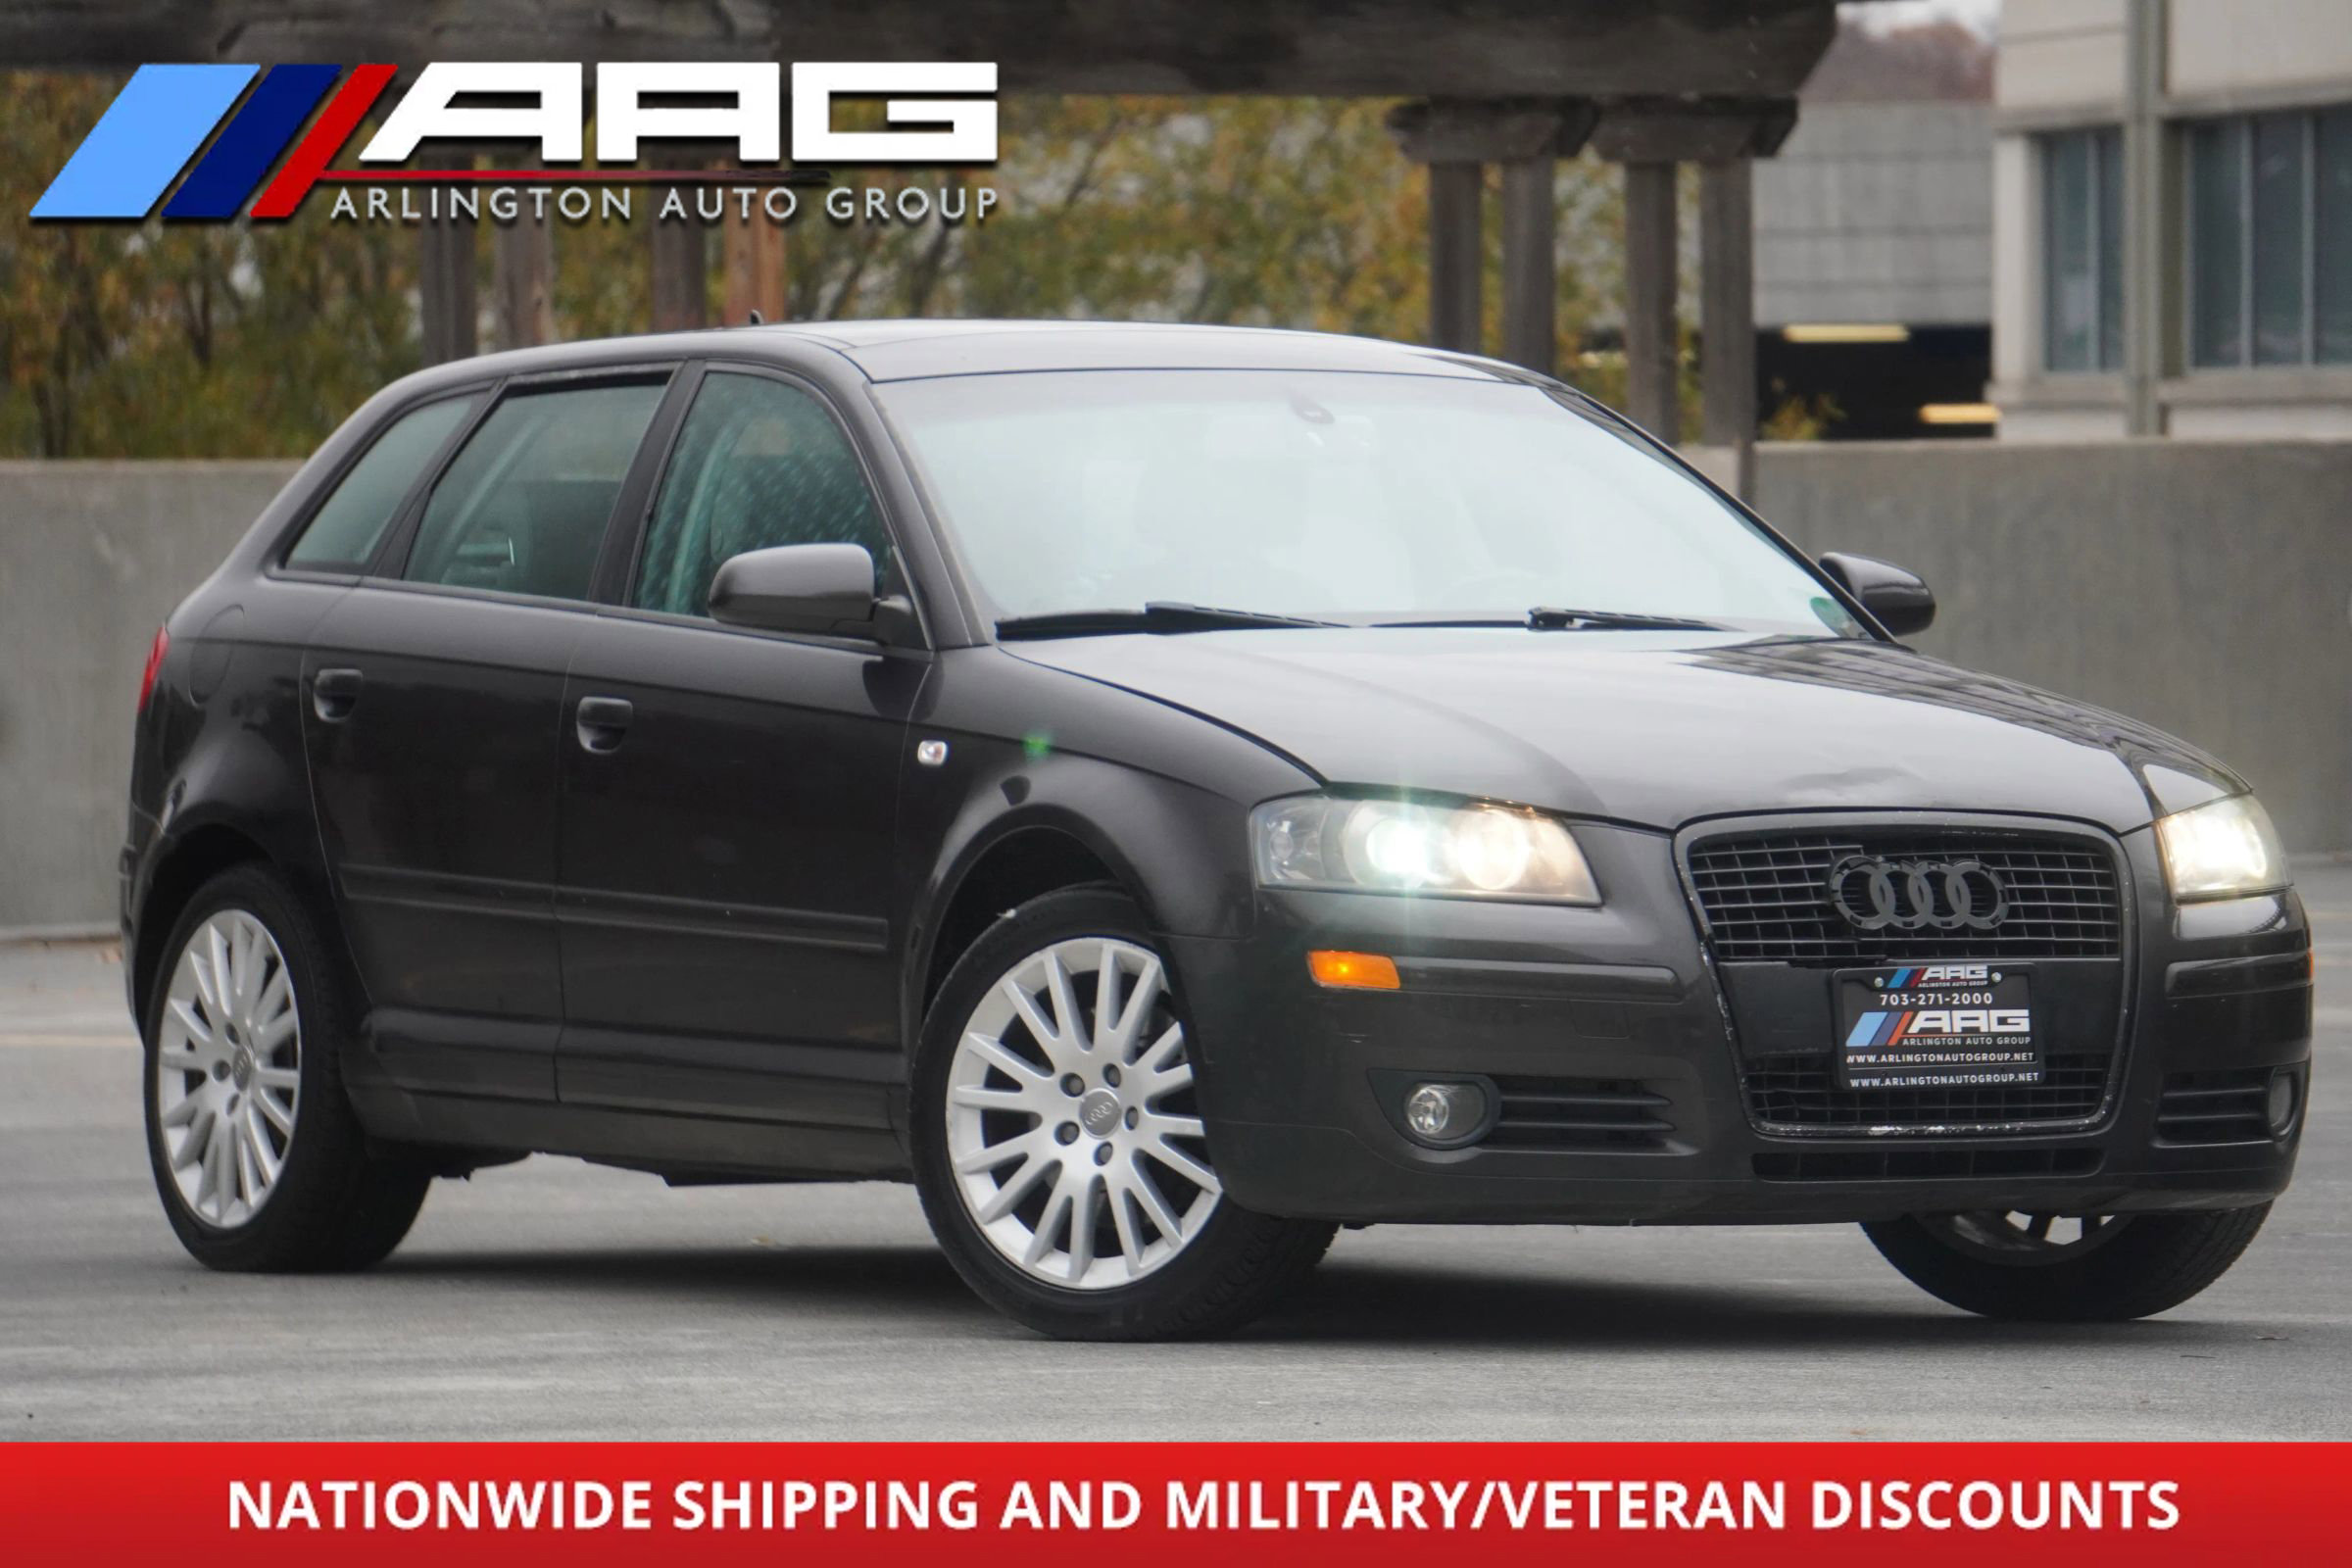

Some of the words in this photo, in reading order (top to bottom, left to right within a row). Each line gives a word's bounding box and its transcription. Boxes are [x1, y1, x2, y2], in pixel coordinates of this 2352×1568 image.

[1921, 965, 1987, 981] AAG
[1880, 993, 1993, 1005] 703-271-2000
[1907, 1009, 2031, 1033] AAG
[1902, 1037, 1961, 1046] ARLINGTON
[1965, 1037, 1993, 1046] AUTO
[1996, 1036, 2032, 1045] GROUP
[1846, 1052, 2034, 1064] WWW.ARLINGTONAUTOGROUP.NET
[1850, 1072, 2039, 1088] WWW.ARLINGTONAUTOGROUP.NET
